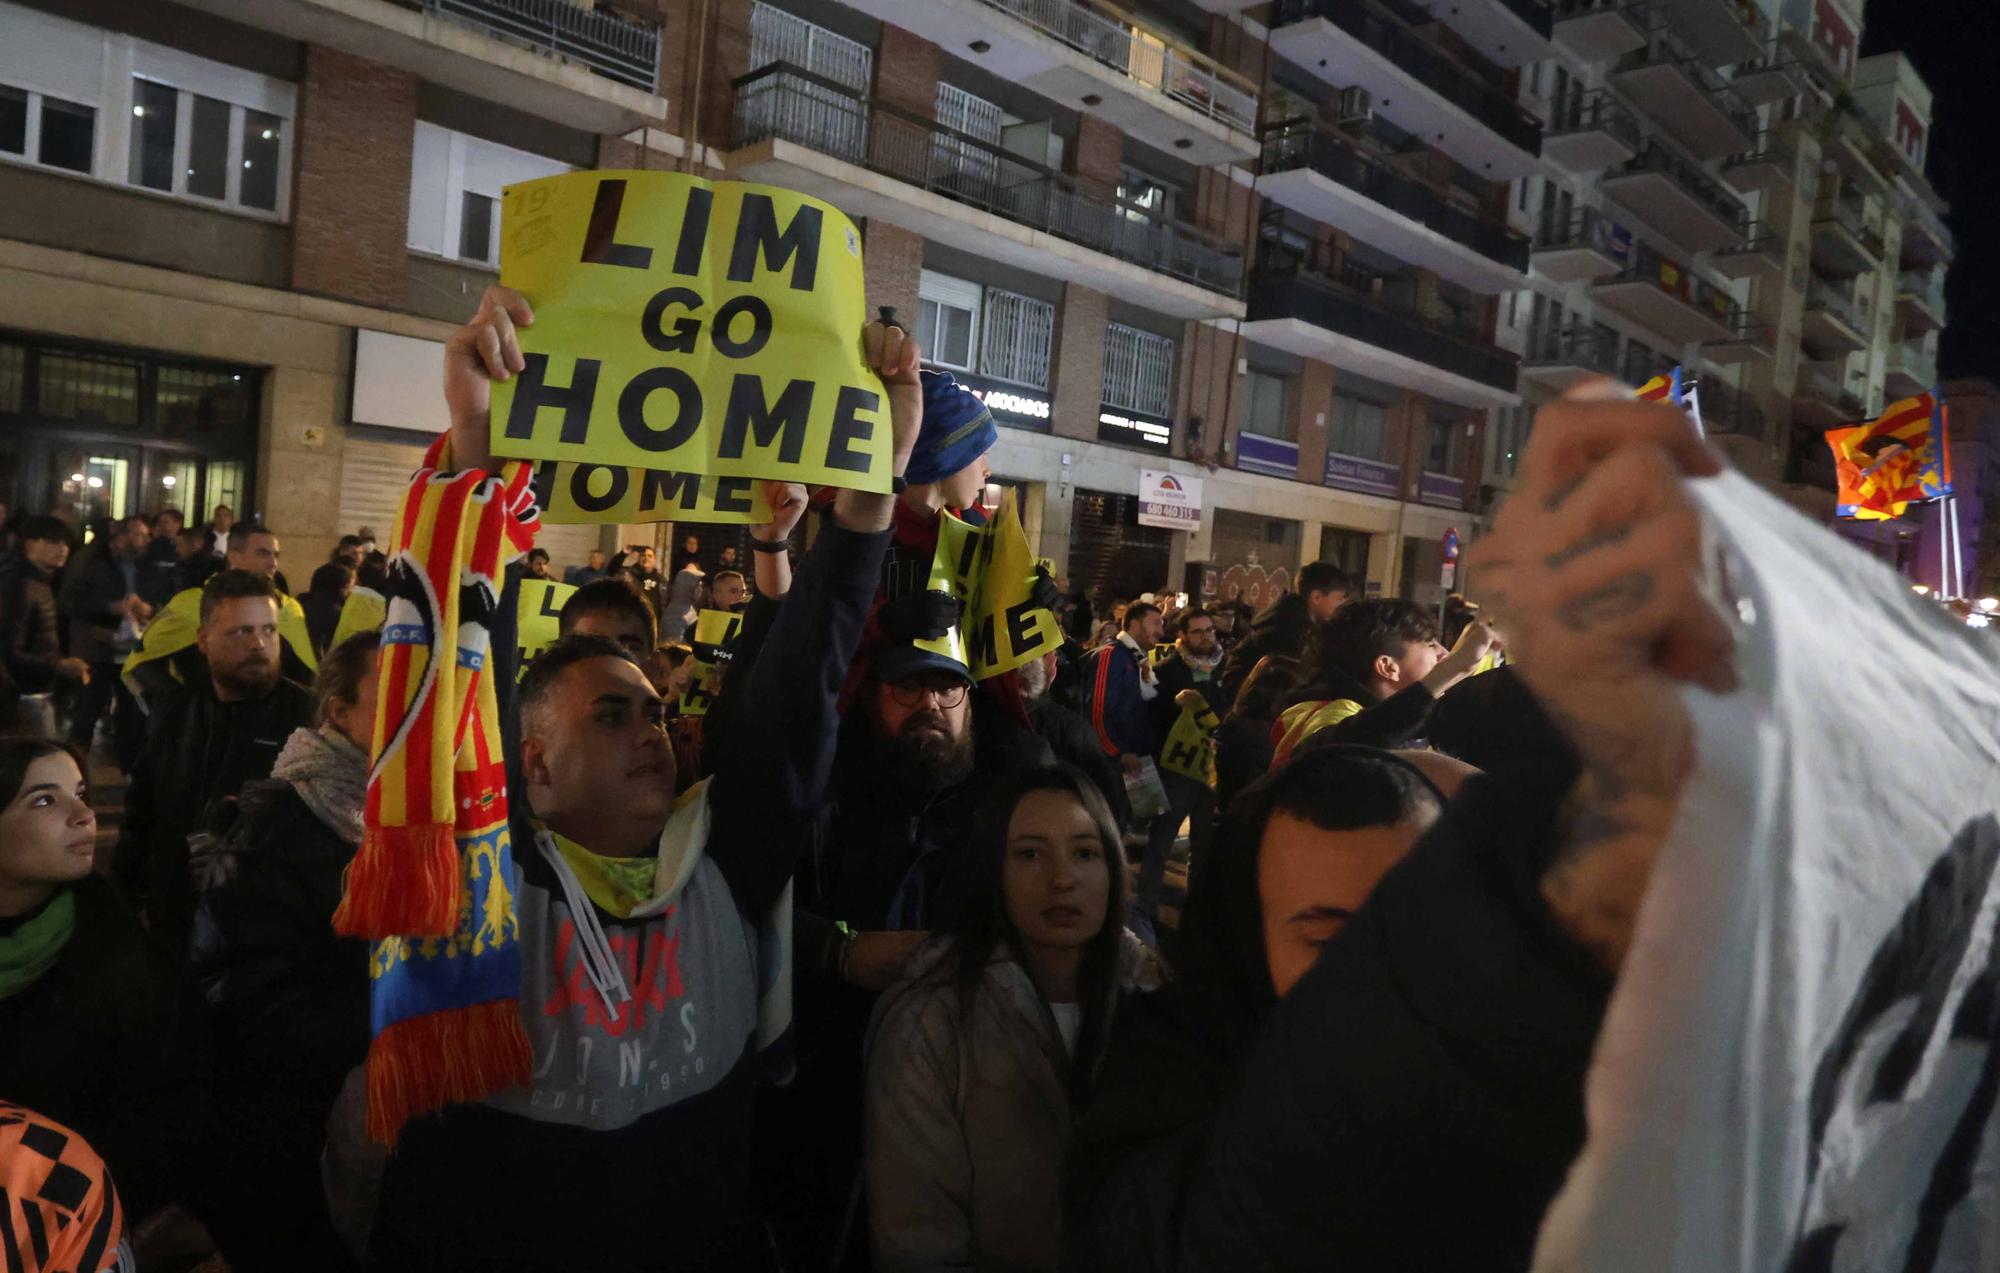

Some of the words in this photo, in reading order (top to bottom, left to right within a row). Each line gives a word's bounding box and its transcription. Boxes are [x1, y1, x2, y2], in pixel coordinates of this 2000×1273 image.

[580, 179, 823, 292] LIM
[641, 287, 773, 359] GO
[504, 351, 880, 474] HOME
